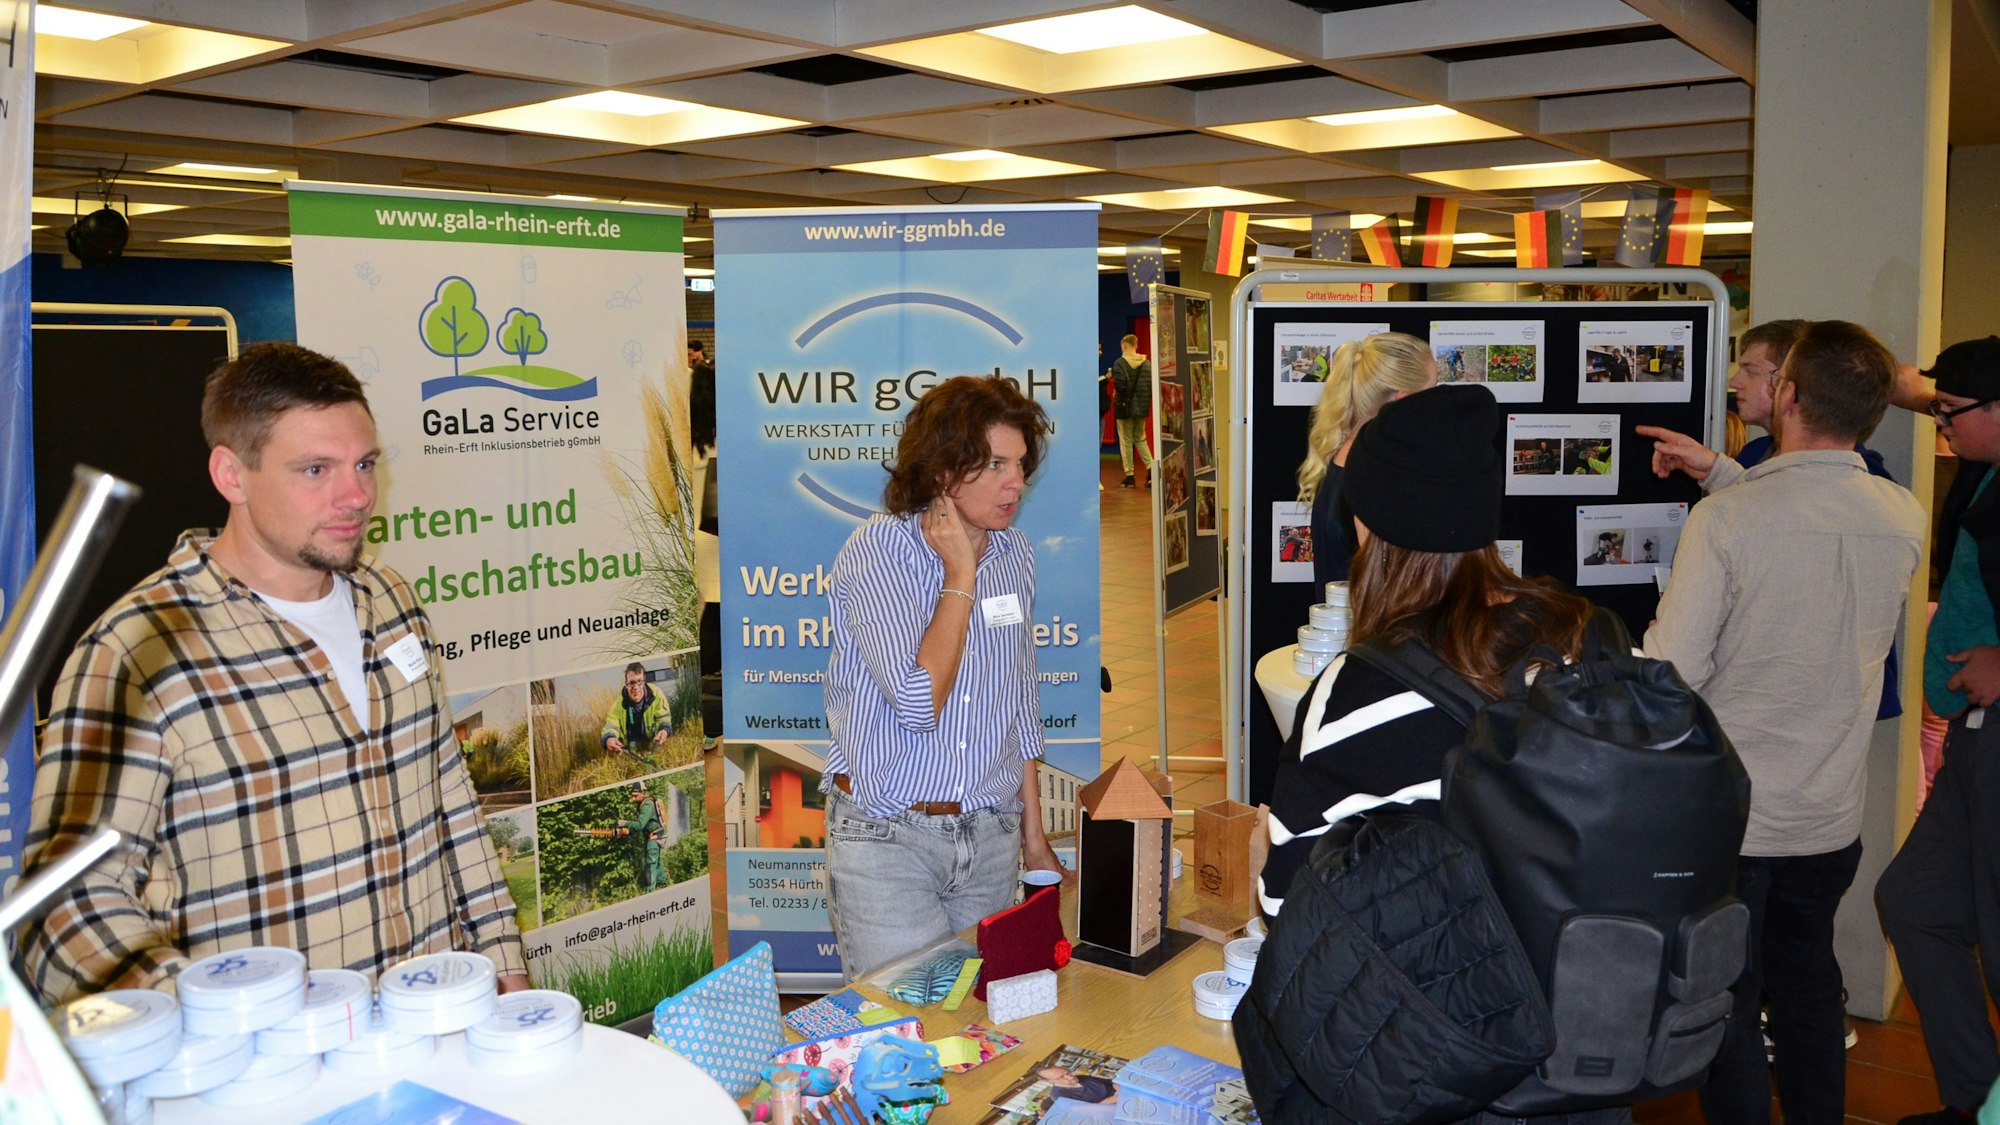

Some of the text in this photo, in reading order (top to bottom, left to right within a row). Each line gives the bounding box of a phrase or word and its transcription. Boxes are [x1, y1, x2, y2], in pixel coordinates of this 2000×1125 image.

[375, 208, 621, 239] www.gala-rhein-erft.de
[804, 219, 1006, 242] www.wir-ggmbh.de
[1306, 291, 1326, 301] Caritas
[758, 367, 1057, 411] WIR gGH
[422, 405, 600, 436] GaLa Service
[764, 420, 906, 438] WERKSTATT FÜ
[423, 435, 601, 455] Rhein-Erft Inklusionsbetrieb gGmbH
[808, 447, 850, 461] UND
[366, 488, 577, 544] arten- und
[413, 547, 642, 605] dschaftsbau
[740, 564, 832, 596] Werk
[471, 630, 531, 652] Pflege
[537, 618, 572, 641] und
[578, 607, 670, 635] Neuanlage
[742, 616, 785, 647] im
[743, 669, 765, 683] für
[769, 669, 826, 683] Mensch
[745, 714, 821, 729] Werkstatt
[748, 859, 826, 871] Neumannstra
[748, 878, 823, 890] 50354 Hürth
[749, 897, 769, 908] Tel.
[772, 898, 809, 909] 02233
[526, 896, 696, 960] ürth info@gala-rhein-erft.de
